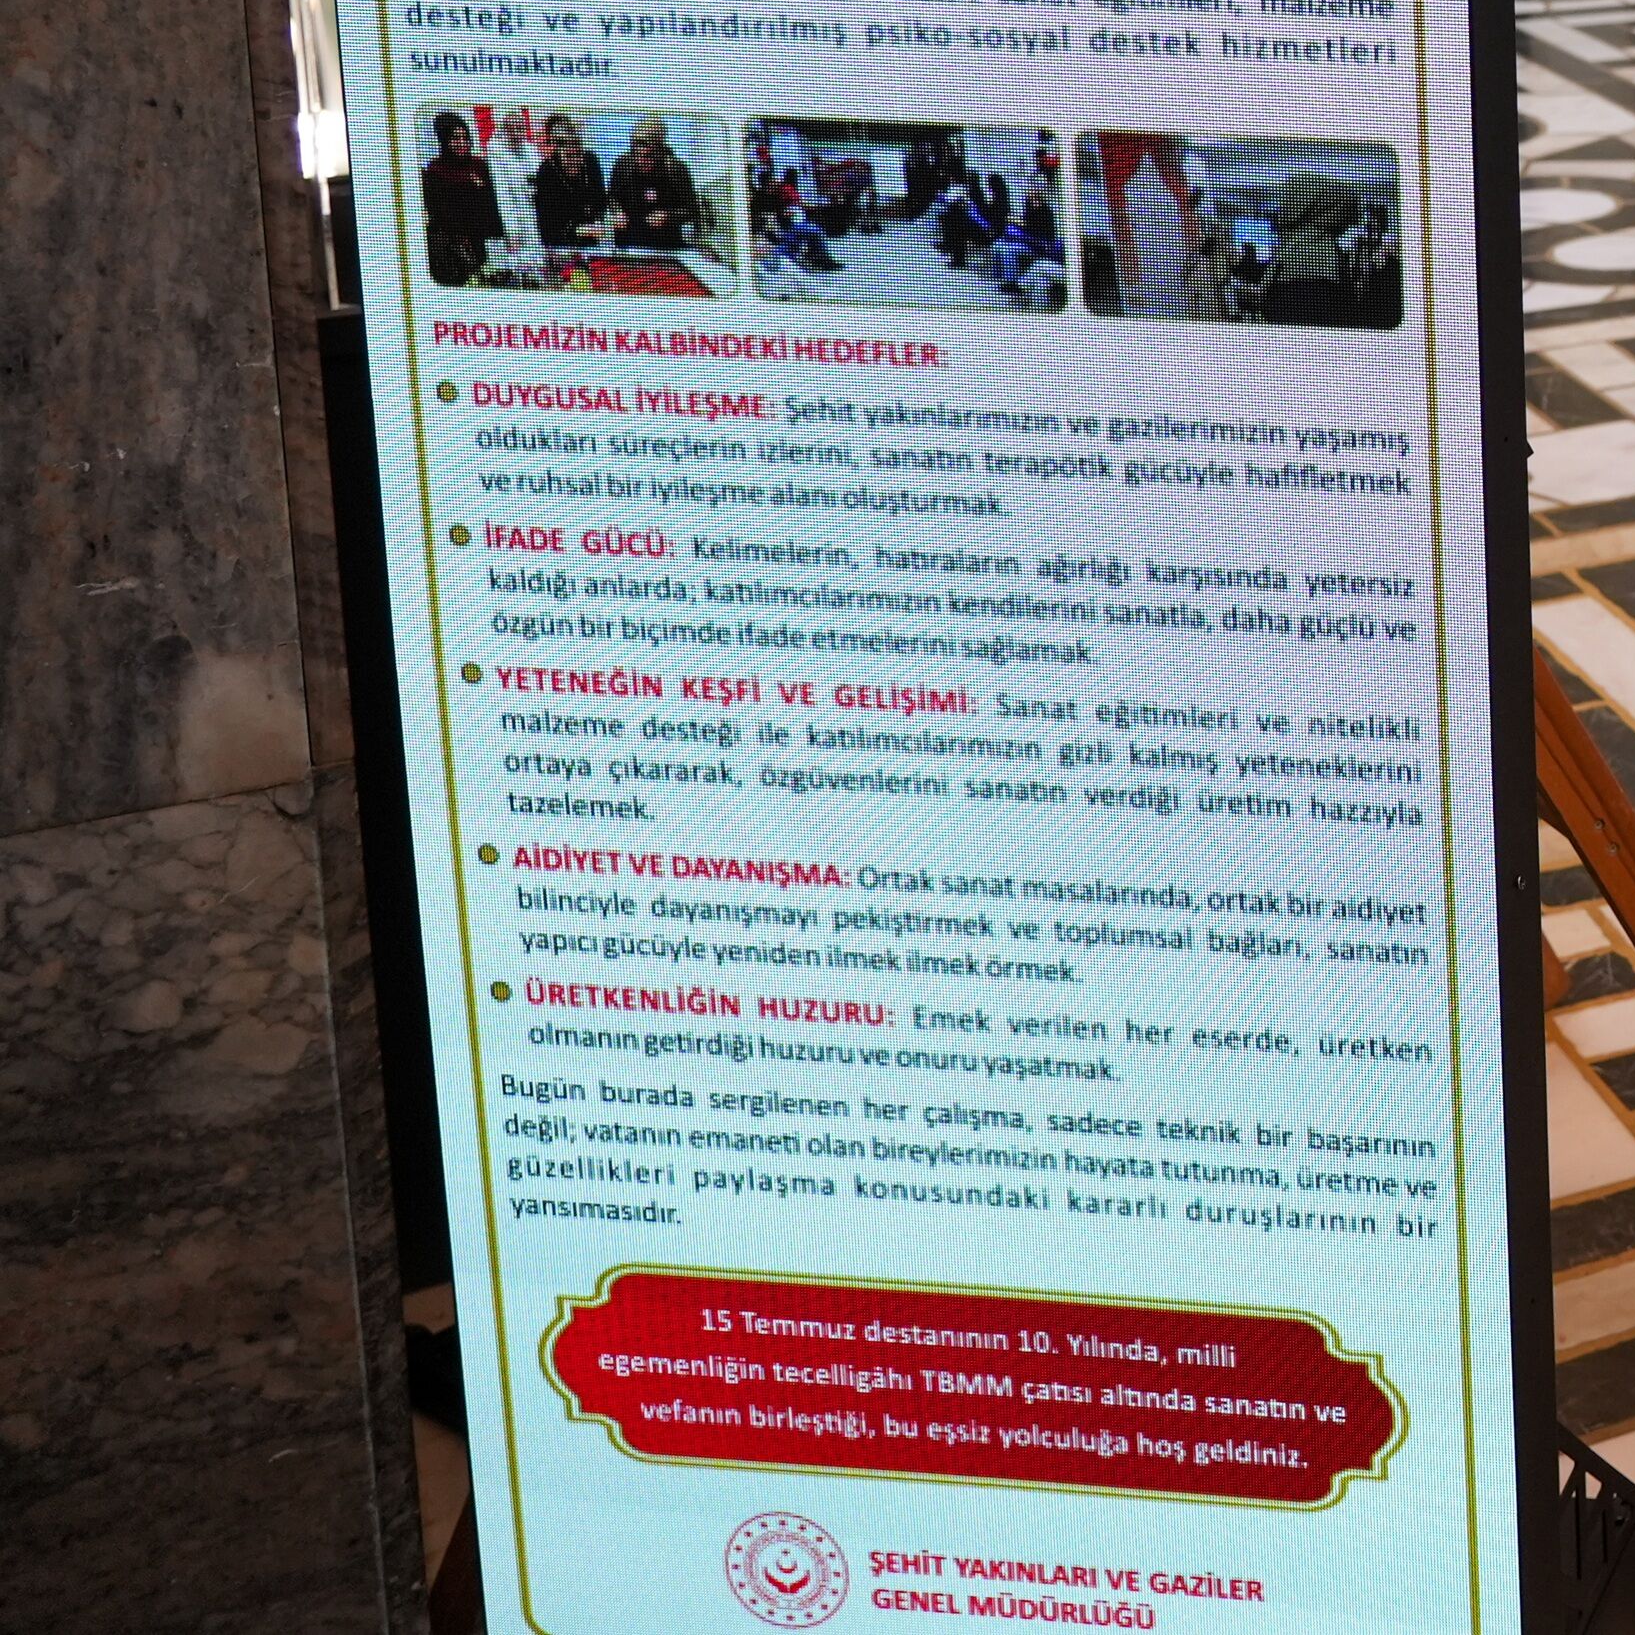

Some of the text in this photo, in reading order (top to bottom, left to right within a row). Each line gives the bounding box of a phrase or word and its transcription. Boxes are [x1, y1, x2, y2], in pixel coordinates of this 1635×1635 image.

[404, 0, 1396, 63] desteği ve yapılandırılmış psiko-sosyal destek hizmetleri
[409, 45, 618, 80] sunulmaktadır.
[433, 321, 948, 369] PROJEMİZİN KALBİNDEKİ HEDEFLER:
[471, 382, 1411, 457] DUYGUSAL İYİLEŞME: Şehit yakınlarımızın ve gazilerimizin yaşamış
[482, 519, 1413, 598] İFADE GÜCÜ: Kelimelerin, hatıraların ağırlığı karşısında yetersiz
[496, 667, 1421, 743] YETENEĞİN KEŞFİ VE GELİŞİMİ: Sanat eğitimleri ve nitelikli
[506, 790, 655, 822] tazelemek.
[513, 840, 1426, 928] AİDİYET VE DAYANIŞMA: Ortak sanat masalarında, ortak bir aidiyet
[524, 975, 1429, 1062] ÜRETKENLİĞİN HUZURU: Emek verilen her eserde, üretken
[499, 1070, 1435, 1159] Bugün burada sergilenen her çalışma, sadece teknik bir başarının
[505, 1153, 1438, 1240] güzellikleri paylaşma konusundaki kararlı duruşlarının bir
[510, 1195, 682, 1227] yansımasıdır.
[702, 1308, 1237, 1368] 15 Temmuz destanının 10. Yılında, milli
[598, 1352, 765, 1384] egemenliğin
[921, 1369, 1013, 1397] TBMM
[1021, 1379, 1092, 1404] çatısı
[1100, 1384, 1197, 1412] altında
[1205, 1395, 1307, 1421] sanatın
[1313, 1403, 1346, 1424] ve
[640, 1398, 1308, 1469] vefanın birleştiği, bu eşsiz yolculuğa hoş geldiniz.
[869, 1548, 1264, 1602] ŞEHİT YAKINLARI VE GAZİLER
[871, 1588, 1156, 1630] GENEL MÜDÜRLÜĞÜ
